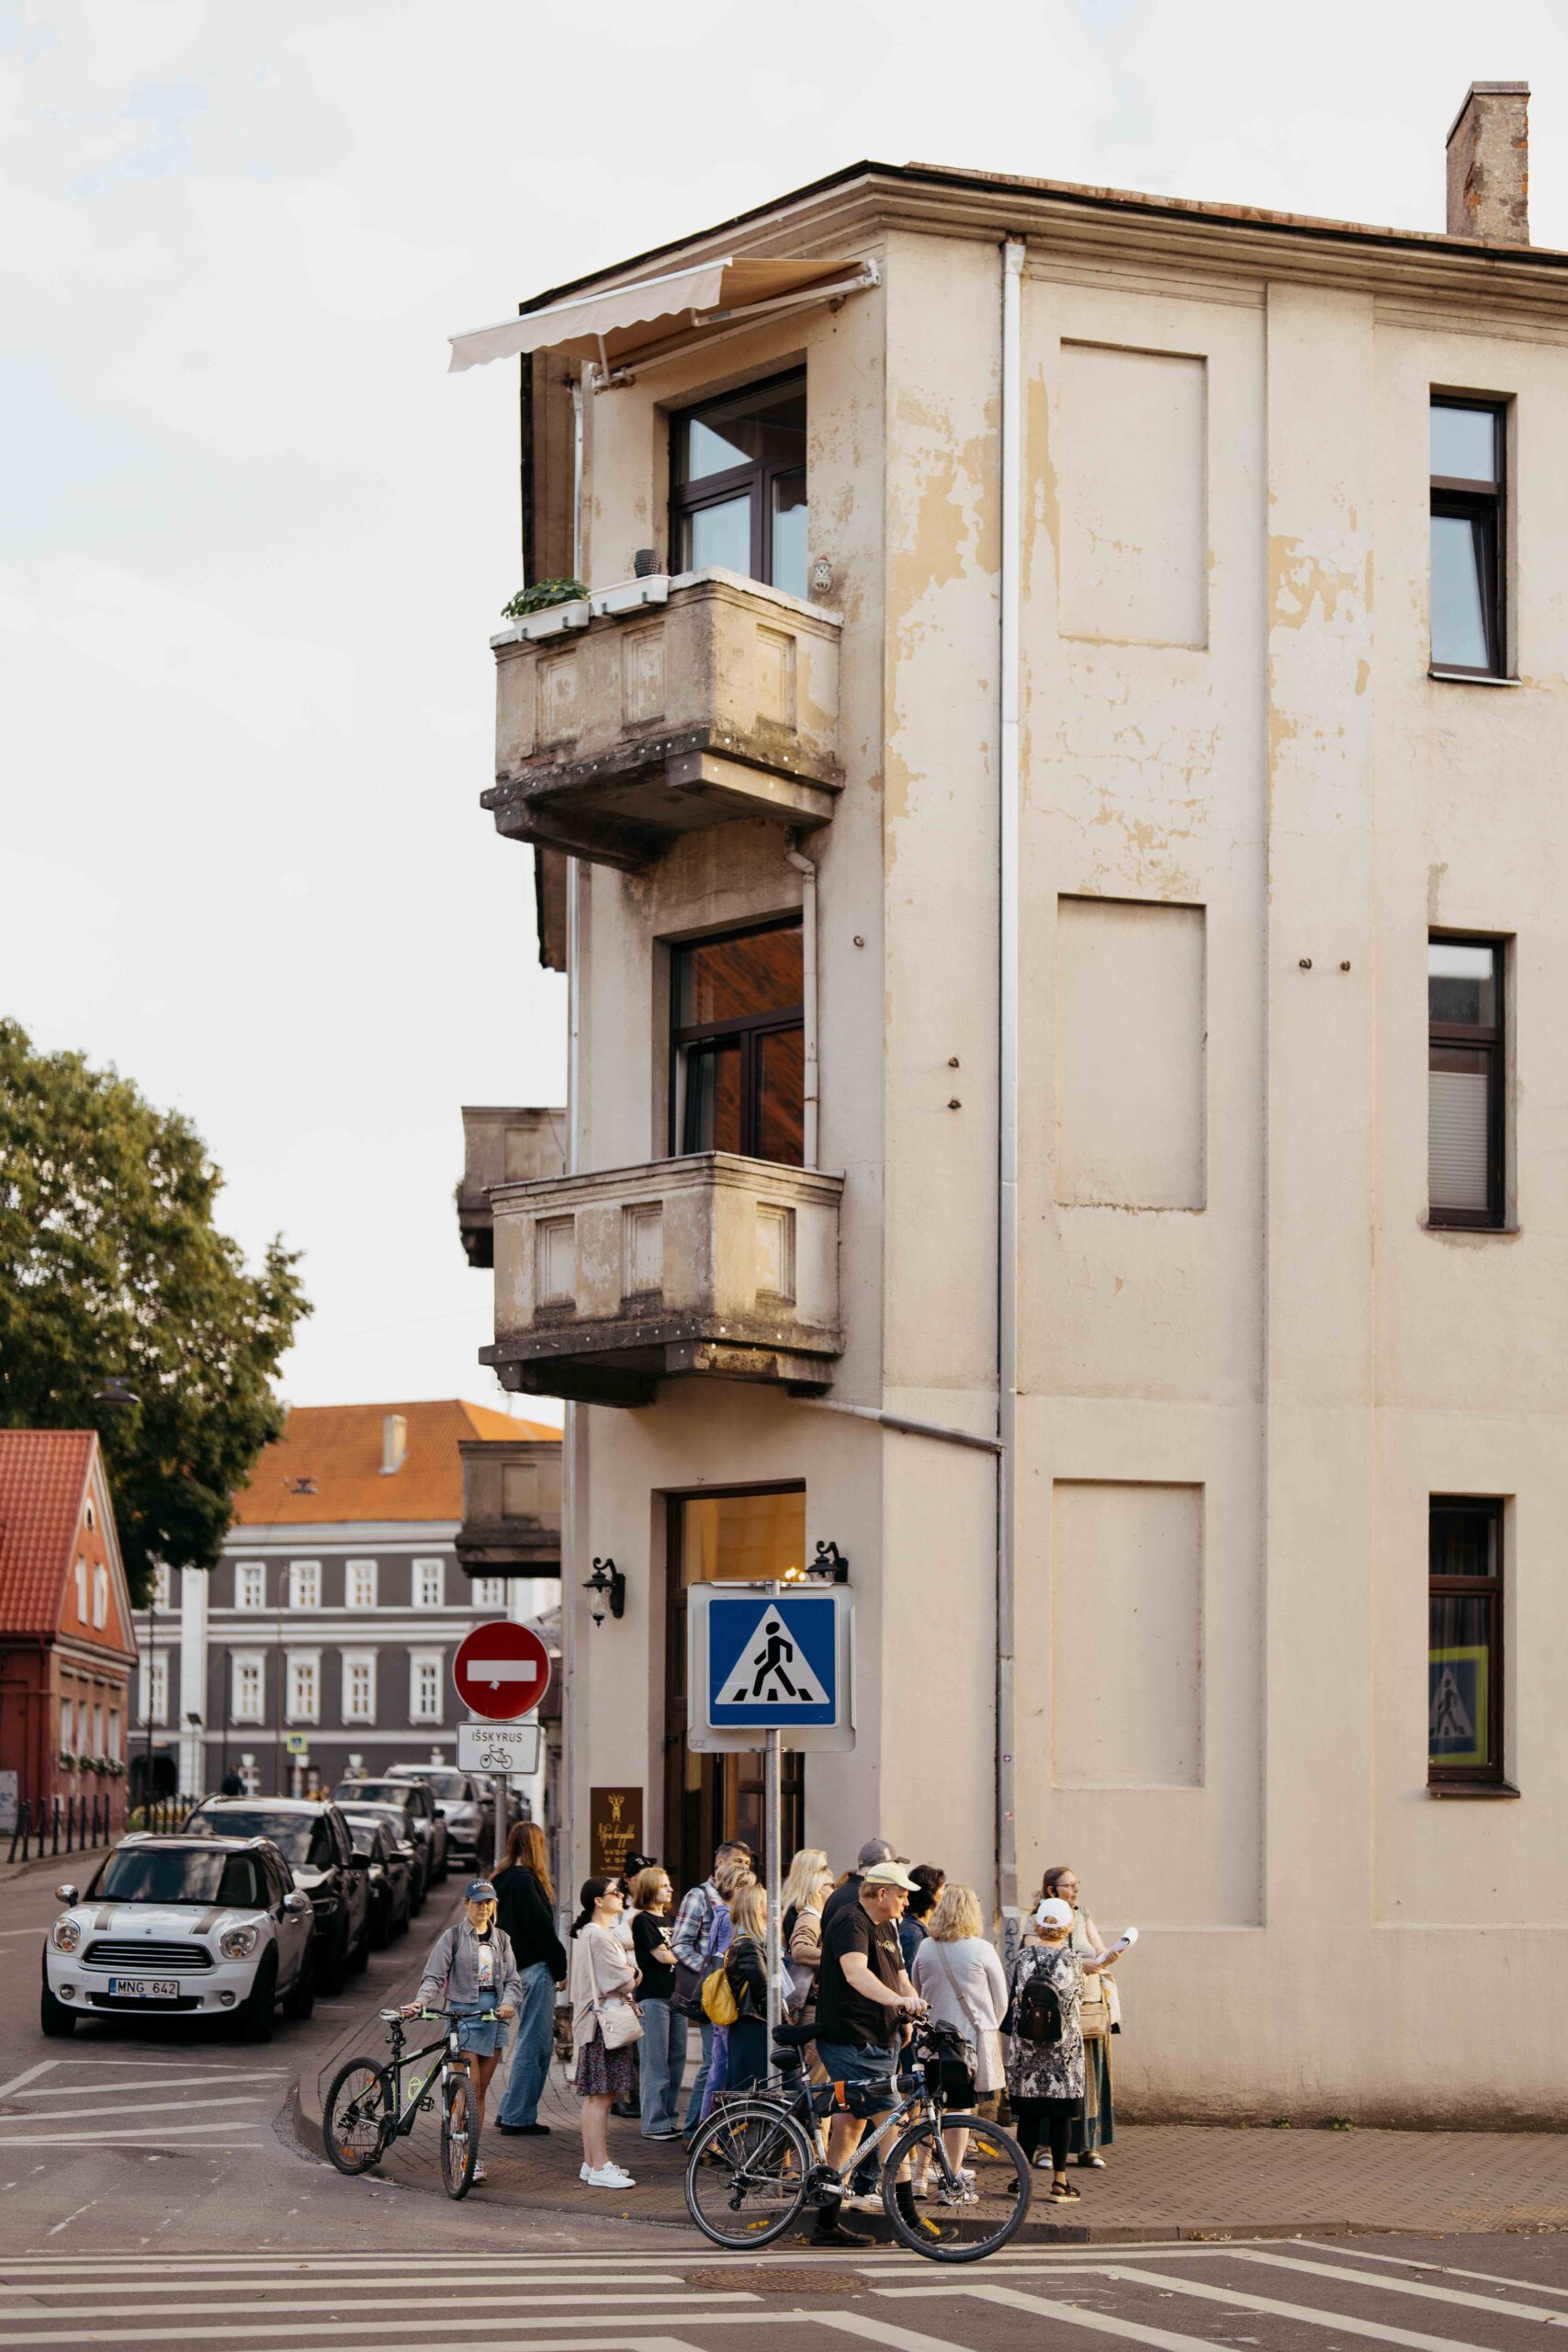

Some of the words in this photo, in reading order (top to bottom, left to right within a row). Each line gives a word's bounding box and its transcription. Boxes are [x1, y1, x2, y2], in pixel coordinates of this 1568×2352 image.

[471, 1729, 523, 1743] IŠSKYRUS
[118, 1981, 144, 1993] MNG
[152, 1983, 175, 1995] 642
